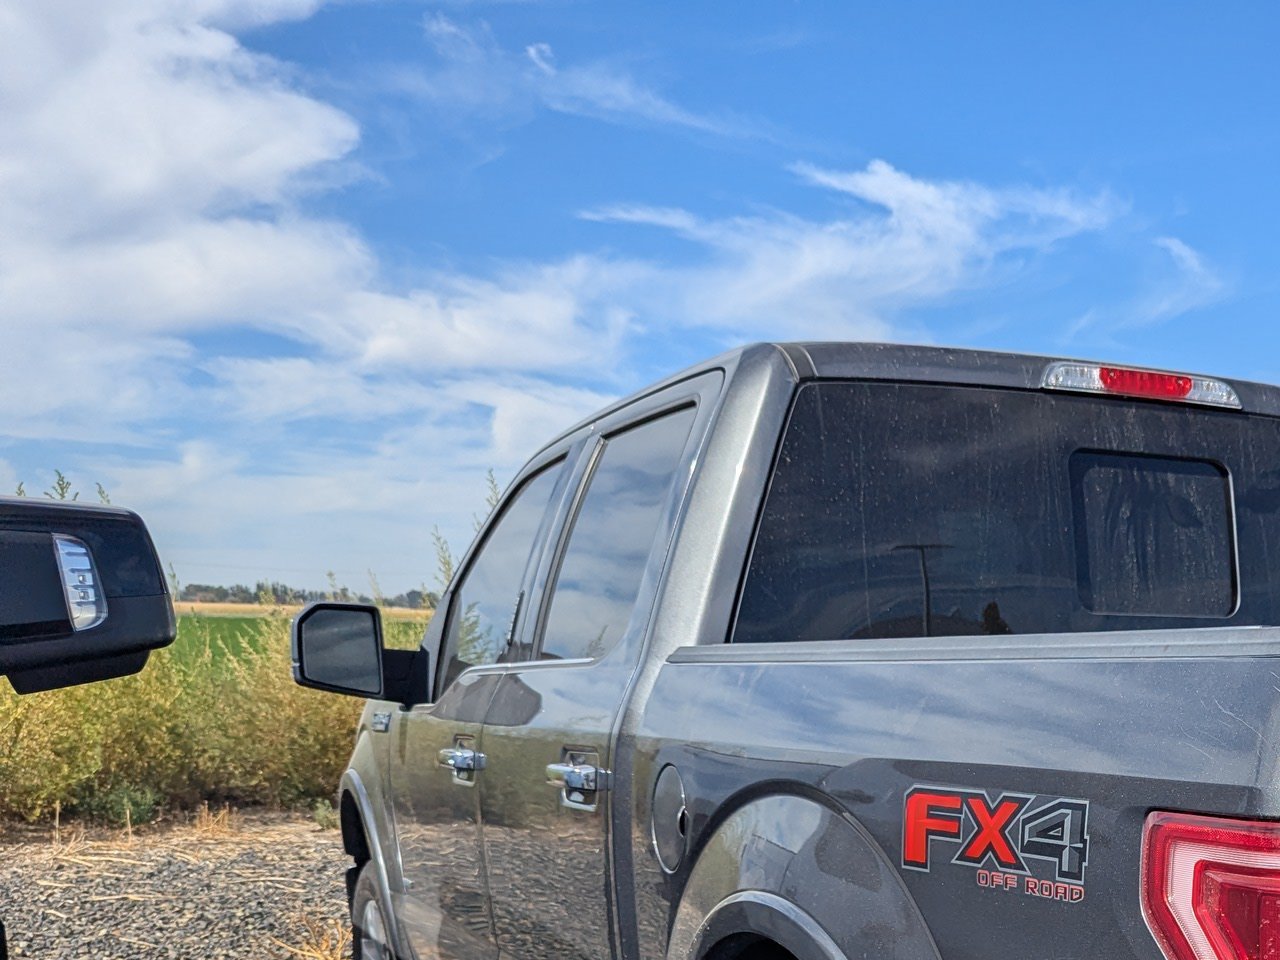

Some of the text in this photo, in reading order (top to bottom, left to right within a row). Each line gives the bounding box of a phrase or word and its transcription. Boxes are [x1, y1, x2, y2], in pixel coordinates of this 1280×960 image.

[902, 784, 1089, 885] FX4
[976, 869, 1085, 903] OFF ROAD
